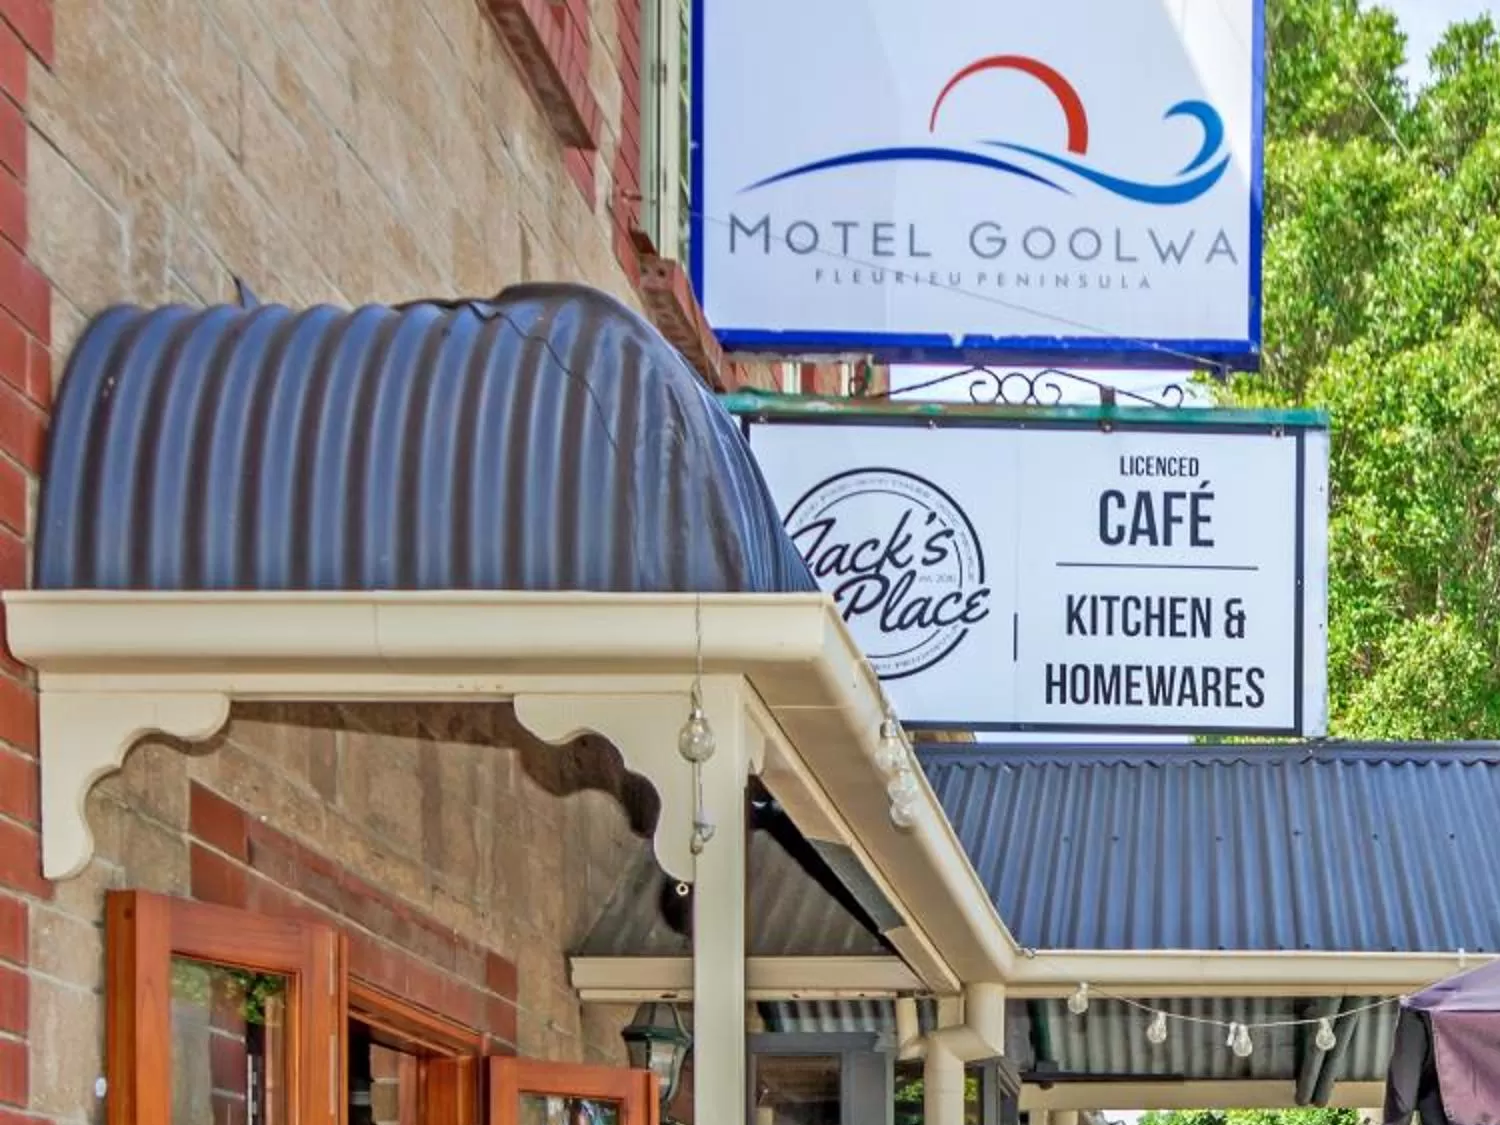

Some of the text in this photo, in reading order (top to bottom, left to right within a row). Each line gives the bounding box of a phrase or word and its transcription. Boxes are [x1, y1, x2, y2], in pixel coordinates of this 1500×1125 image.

[729, 213, 1238, 266] MOTEL GOOLWA
[815, 268, 1152, 290] FLEURIEU PENINSULA
[1119, 455, 1200, 478] LICENCED
[1099, 481, 1216, 549] CAFÉ
[833, 569, 990, 633] Place
[1065, 594, 1247, 640] KITCHEN &
[1044, 663, 1266, 710] HOMEWARES
